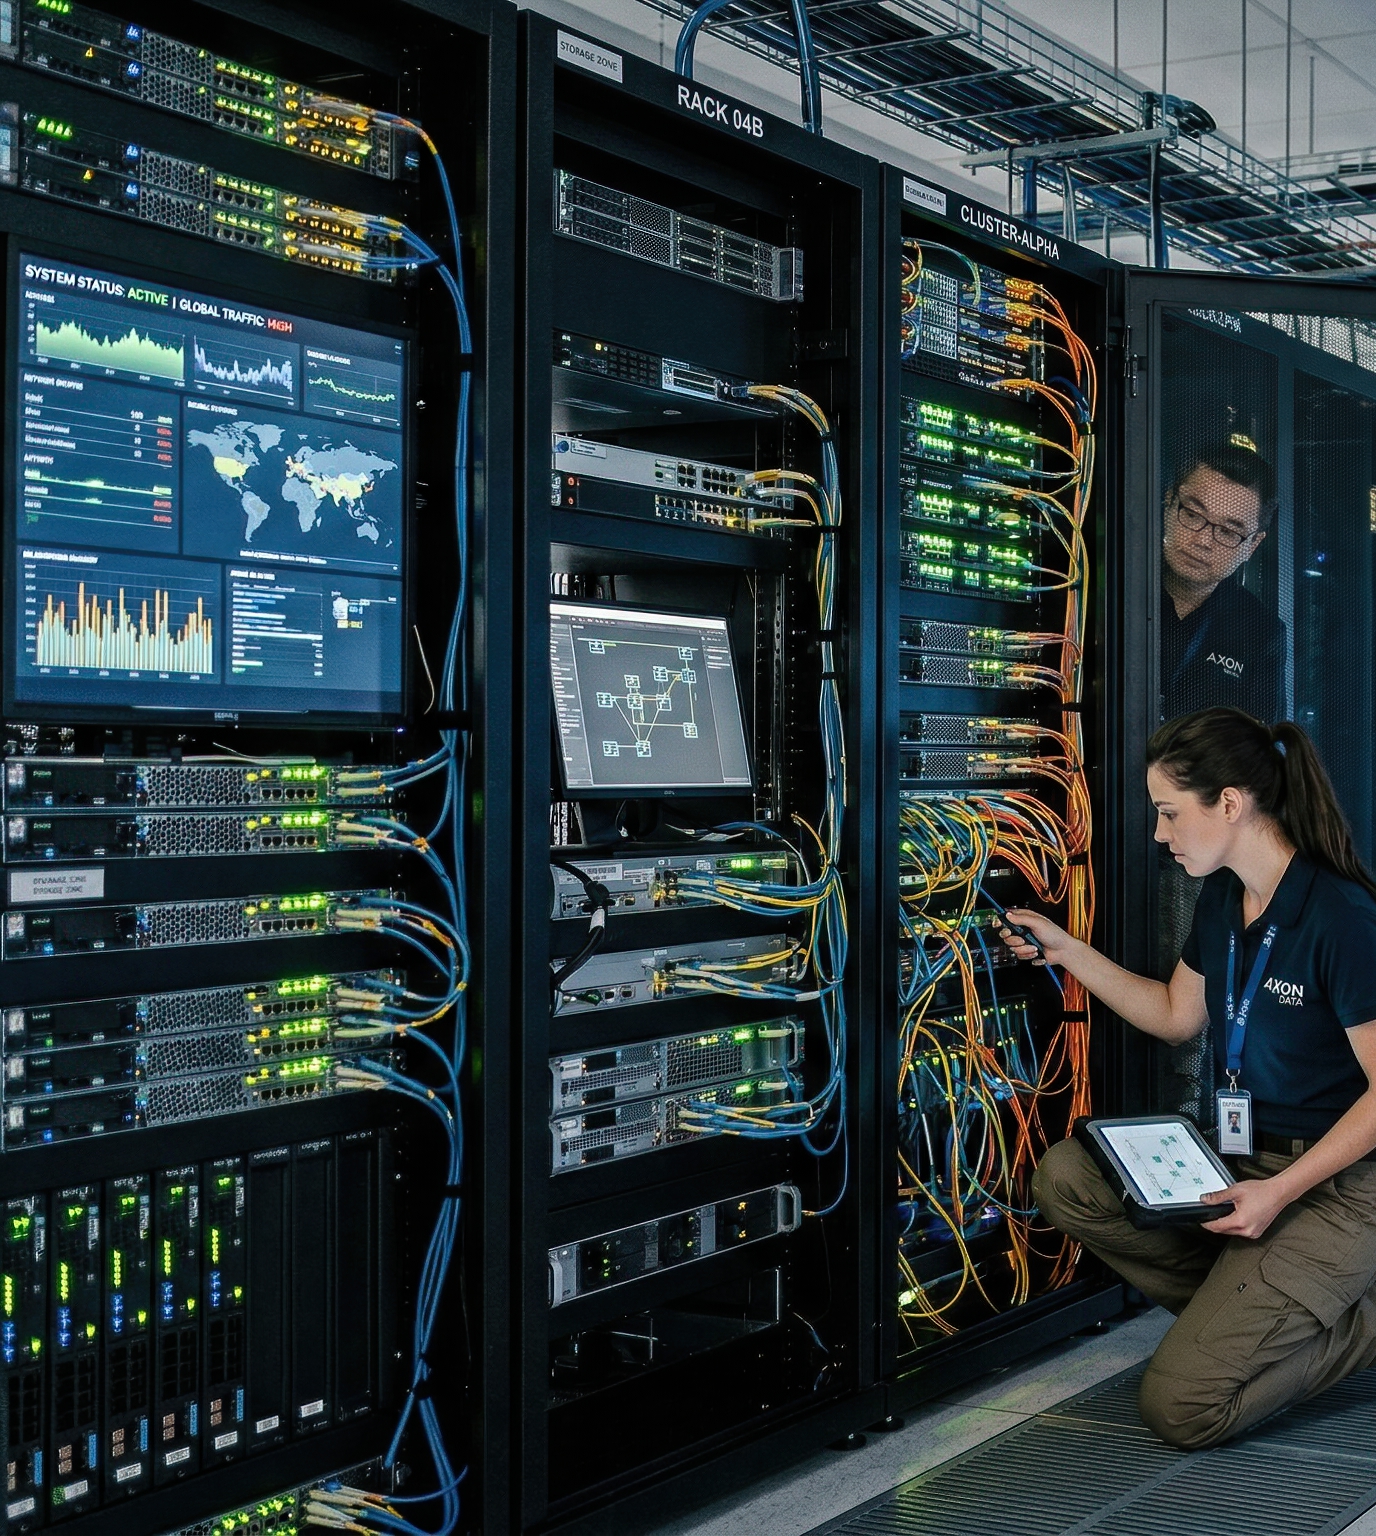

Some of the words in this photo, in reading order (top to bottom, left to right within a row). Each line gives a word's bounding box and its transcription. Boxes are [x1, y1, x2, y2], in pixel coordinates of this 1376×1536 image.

[560, 41, 595, 62] STORAGE
[597, 56, 618, 72] ZONE
[677, 84, 728, 125] RACK
[733, 109, 764, 138] 04B
[961, 204, 1060, 260] CLUSTER-ALPHA
[25, 264, 76, 287] SYSTEM
[77, 276, 125, 298] STATUS:
[127, 287, 169, 306] ACTIVE
[179, 298, 221, 317] GLOBAL
[1206, 652, 1244, 673] AXON
[1263, 977, 1304, 998] AXON
[1278, 995, 1304, 1007] DATA
